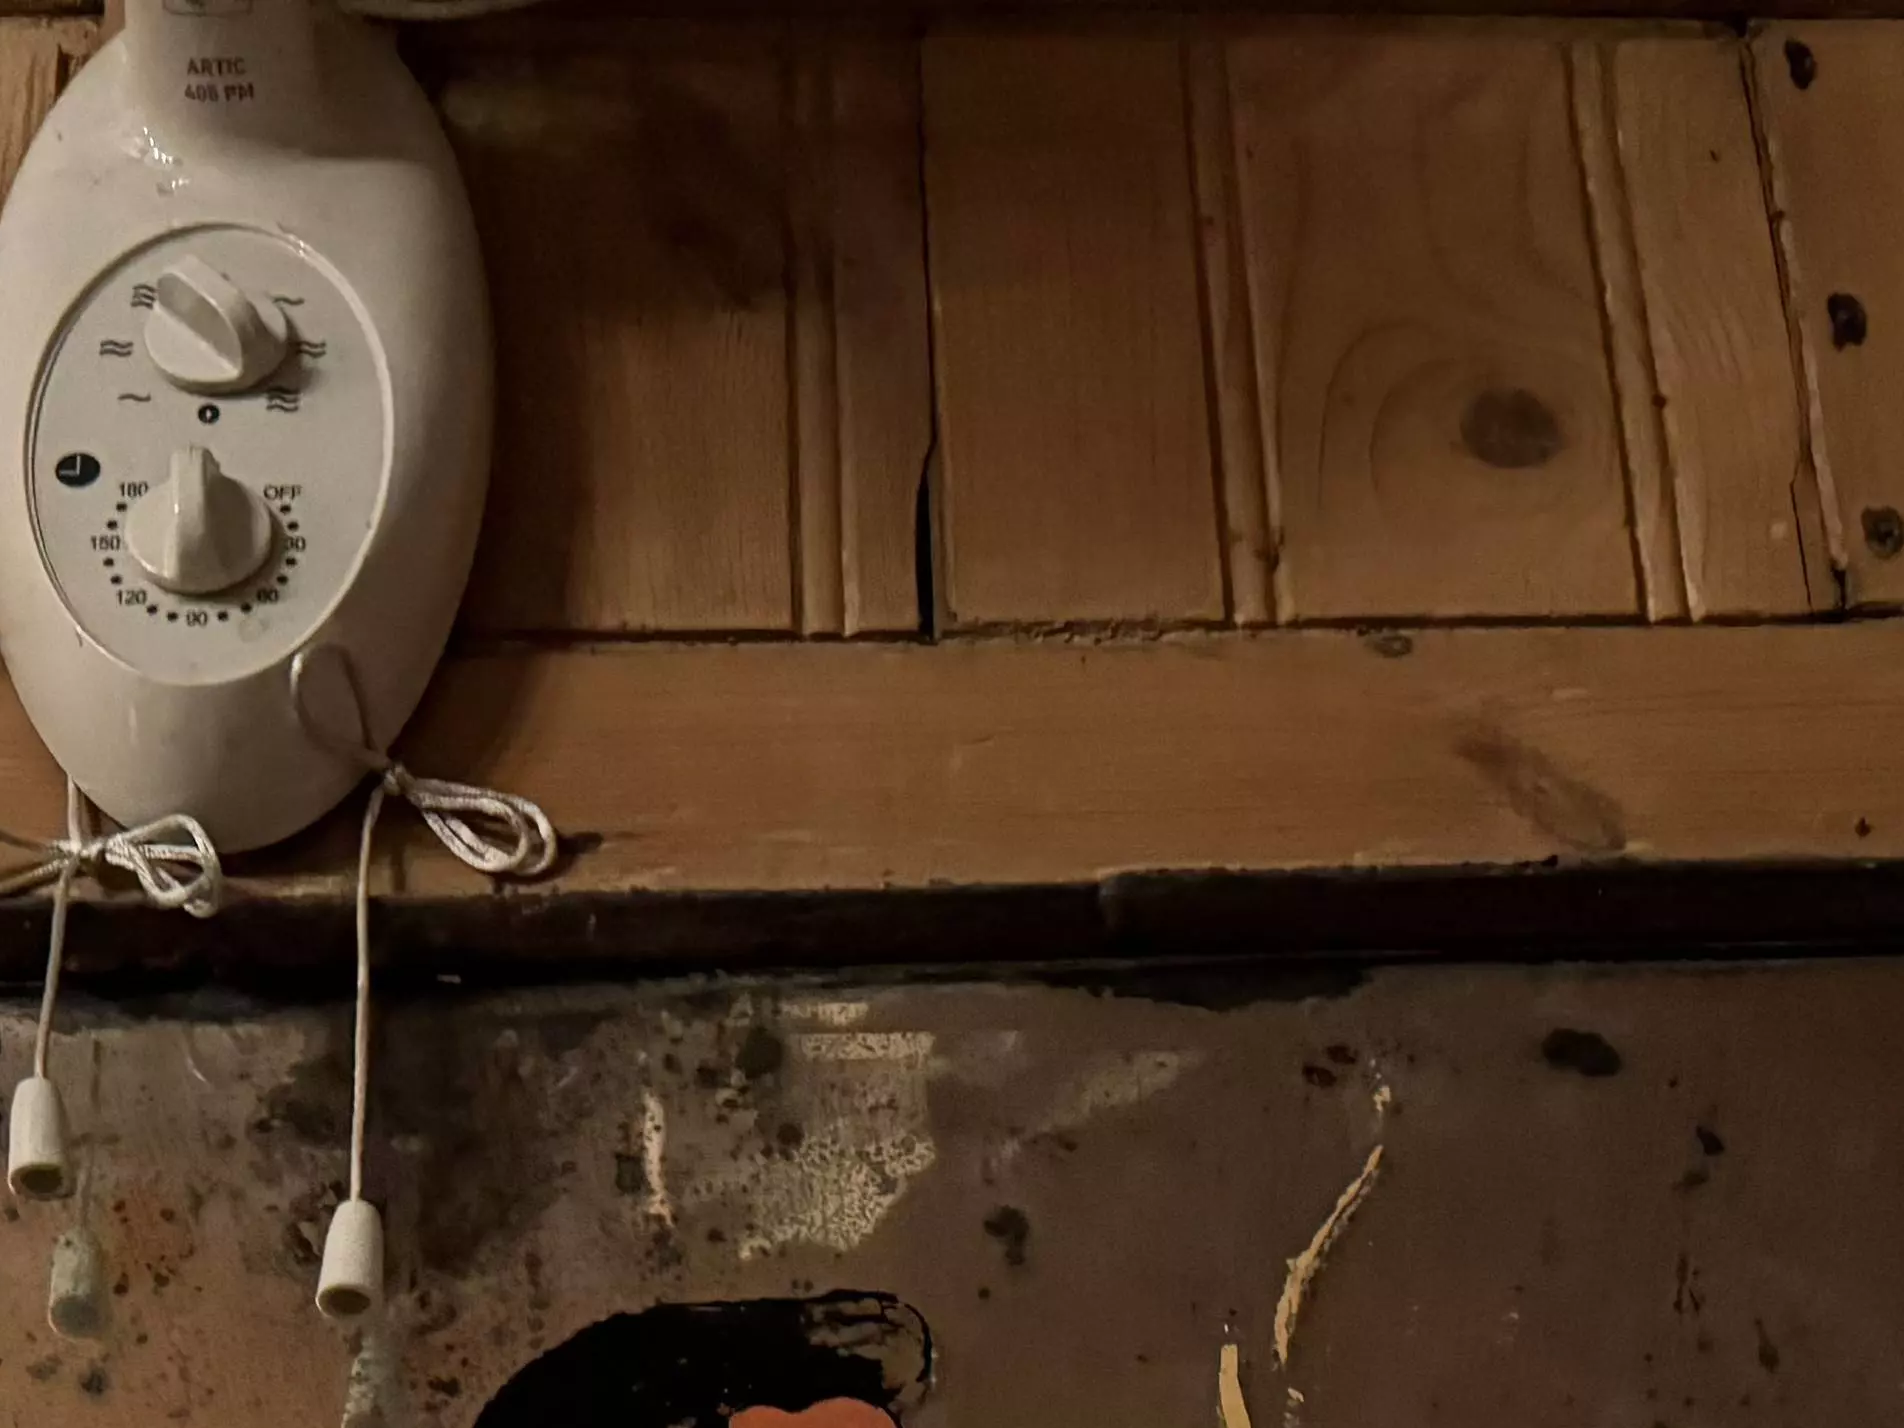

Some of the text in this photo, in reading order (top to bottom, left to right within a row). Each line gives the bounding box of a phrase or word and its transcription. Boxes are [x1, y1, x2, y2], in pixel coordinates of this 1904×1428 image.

[187, 57, 246, 76] ARTIC
[263, 484, 302, 500] OFF
[117, 589, 147, 605] 120
[186, 610, 208, 627] 90
